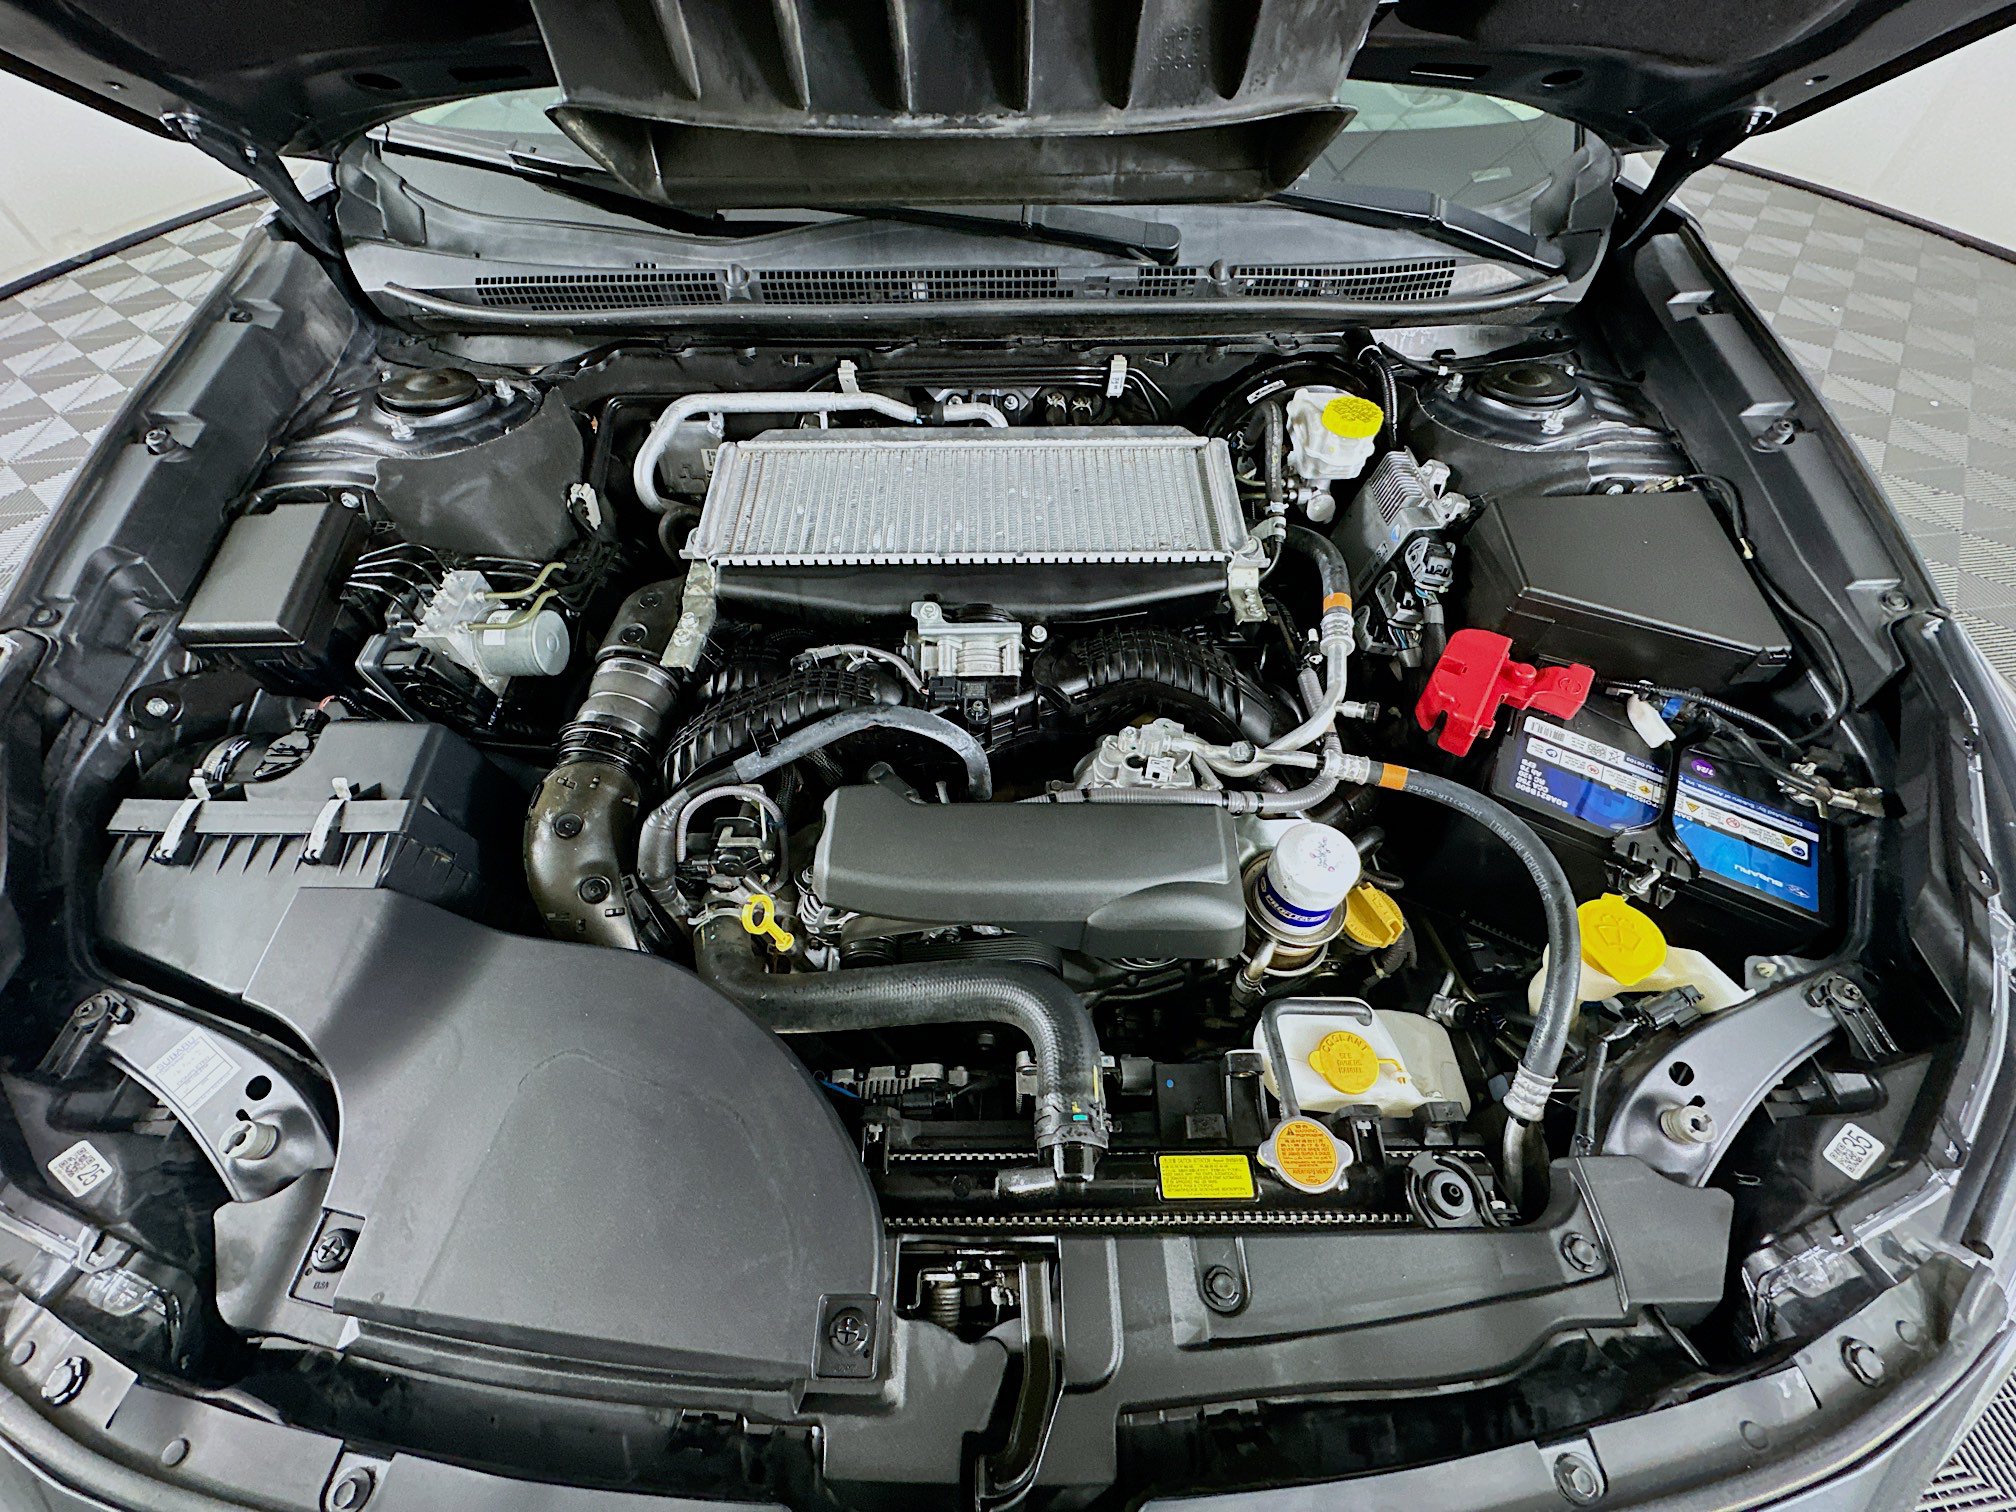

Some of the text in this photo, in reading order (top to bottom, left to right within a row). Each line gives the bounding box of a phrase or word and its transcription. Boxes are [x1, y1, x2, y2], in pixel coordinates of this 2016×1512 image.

[1733, 863, 1784, 888] SUBARU
[155, 1035, 196, 1071] SUBARU
[1322, 1034, 1368, 1052] COOLANT
[1842, 1130, 1873, 1156] 35
[77, 1163, 105, 1186] 25
